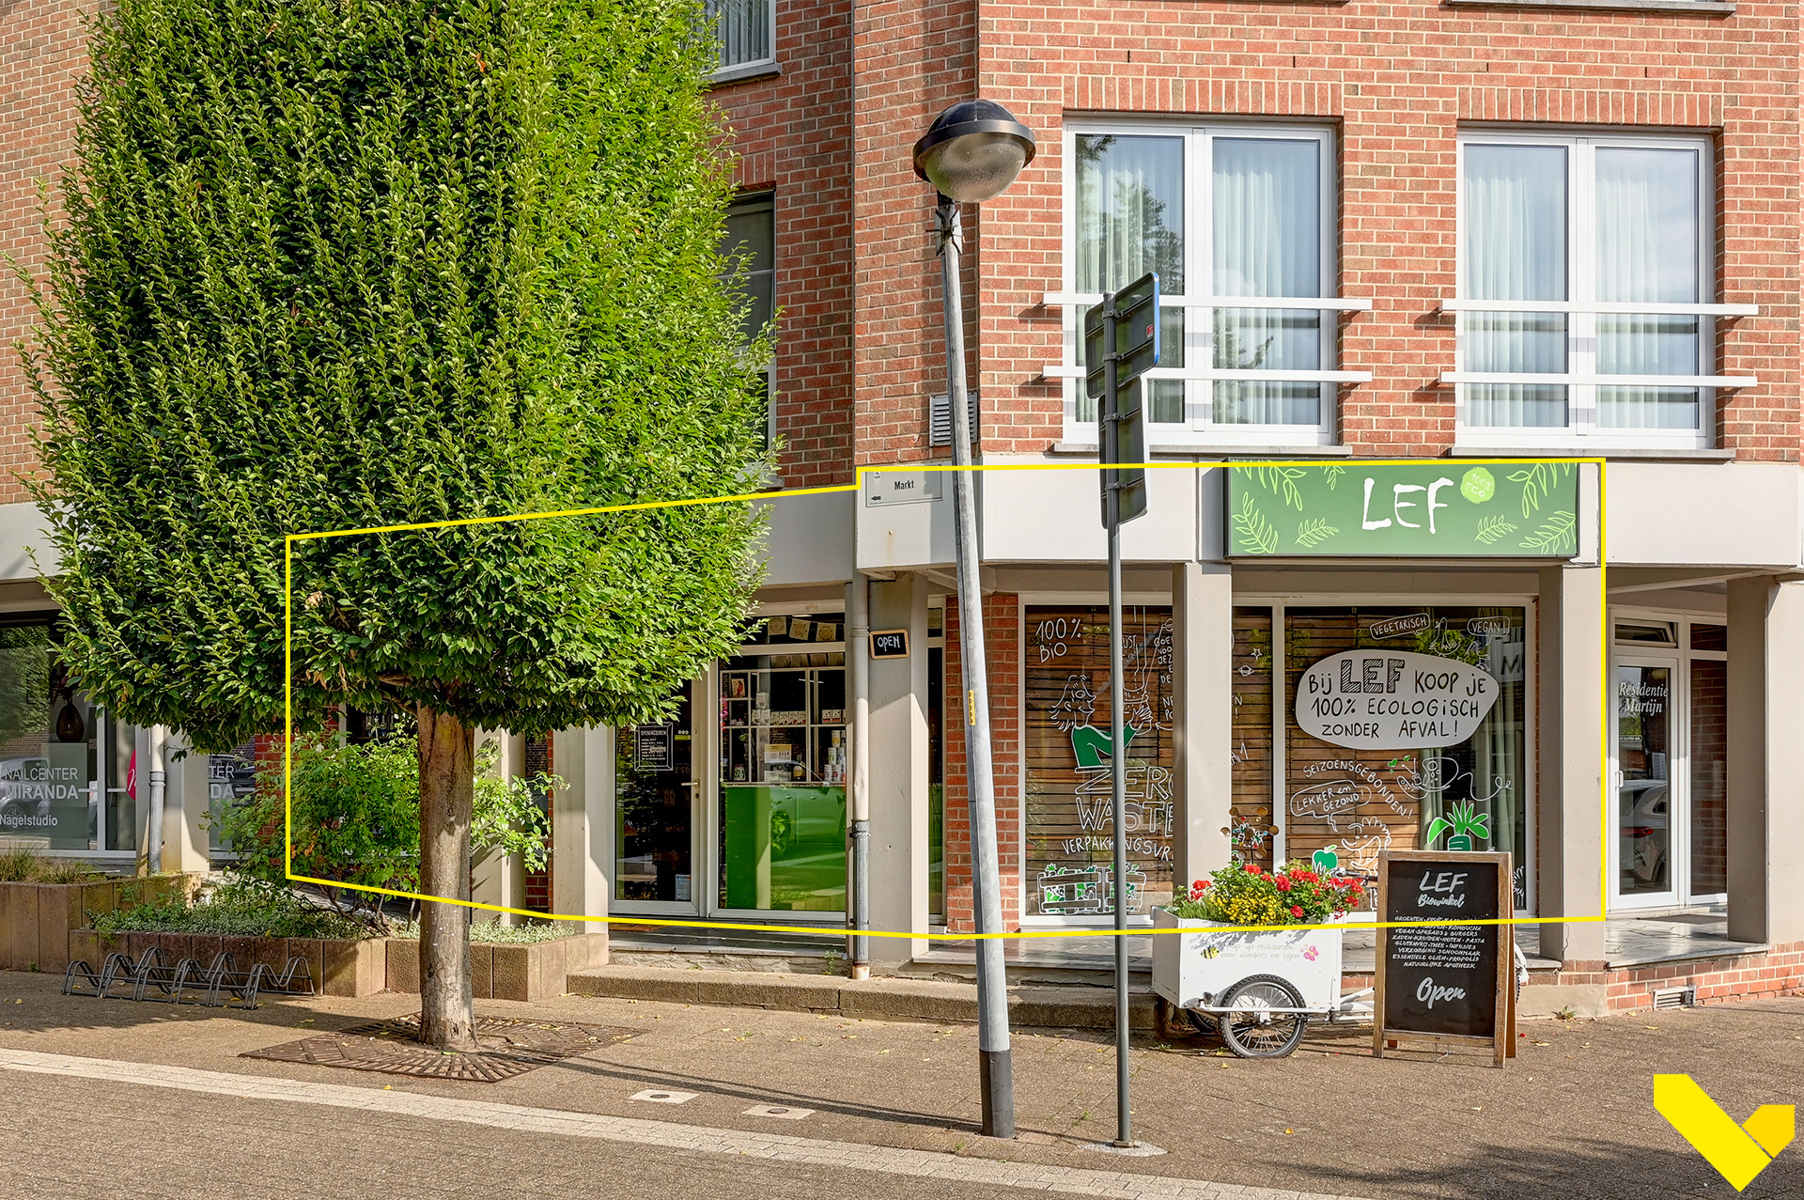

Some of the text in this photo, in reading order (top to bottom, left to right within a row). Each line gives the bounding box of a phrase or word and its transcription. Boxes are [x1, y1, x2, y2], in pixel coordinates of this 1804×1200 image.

[894, 480, 915, 490] Markt
[1465, 481, 1486, 498] ECO
[1471, 473, 1493, 491] 100%
[1361, 477, 1454, 534] LEF
[1035, 617, 1082, 643] 100%
[877, 635, 901, 652] OPEN
[1154, 637, 1172, 647] GOE
[1340, 658, 1406, 694] LEF
[1415, 670, 1459, 694] KOOP
[1619, 682, 1669, 697] Residentie
[1311, 697, 1356, 718] 100%
[1624, 698, 1663, 717] Martijn
[1321, 722, 1380, 739] ZONDER
[5, 767, 79, 780] NAILCENTER
[6, 784, 79, 800] MIRANDA
[1296, 787, 1336, 811] LEKKER
[0, 813, 58, 829] Nagelstudio
[1419, 870, 1469, 893] LEF
[1417, 893, 1465, 908] Biowinkel
[1416, 977, 1467, 1010] Open
